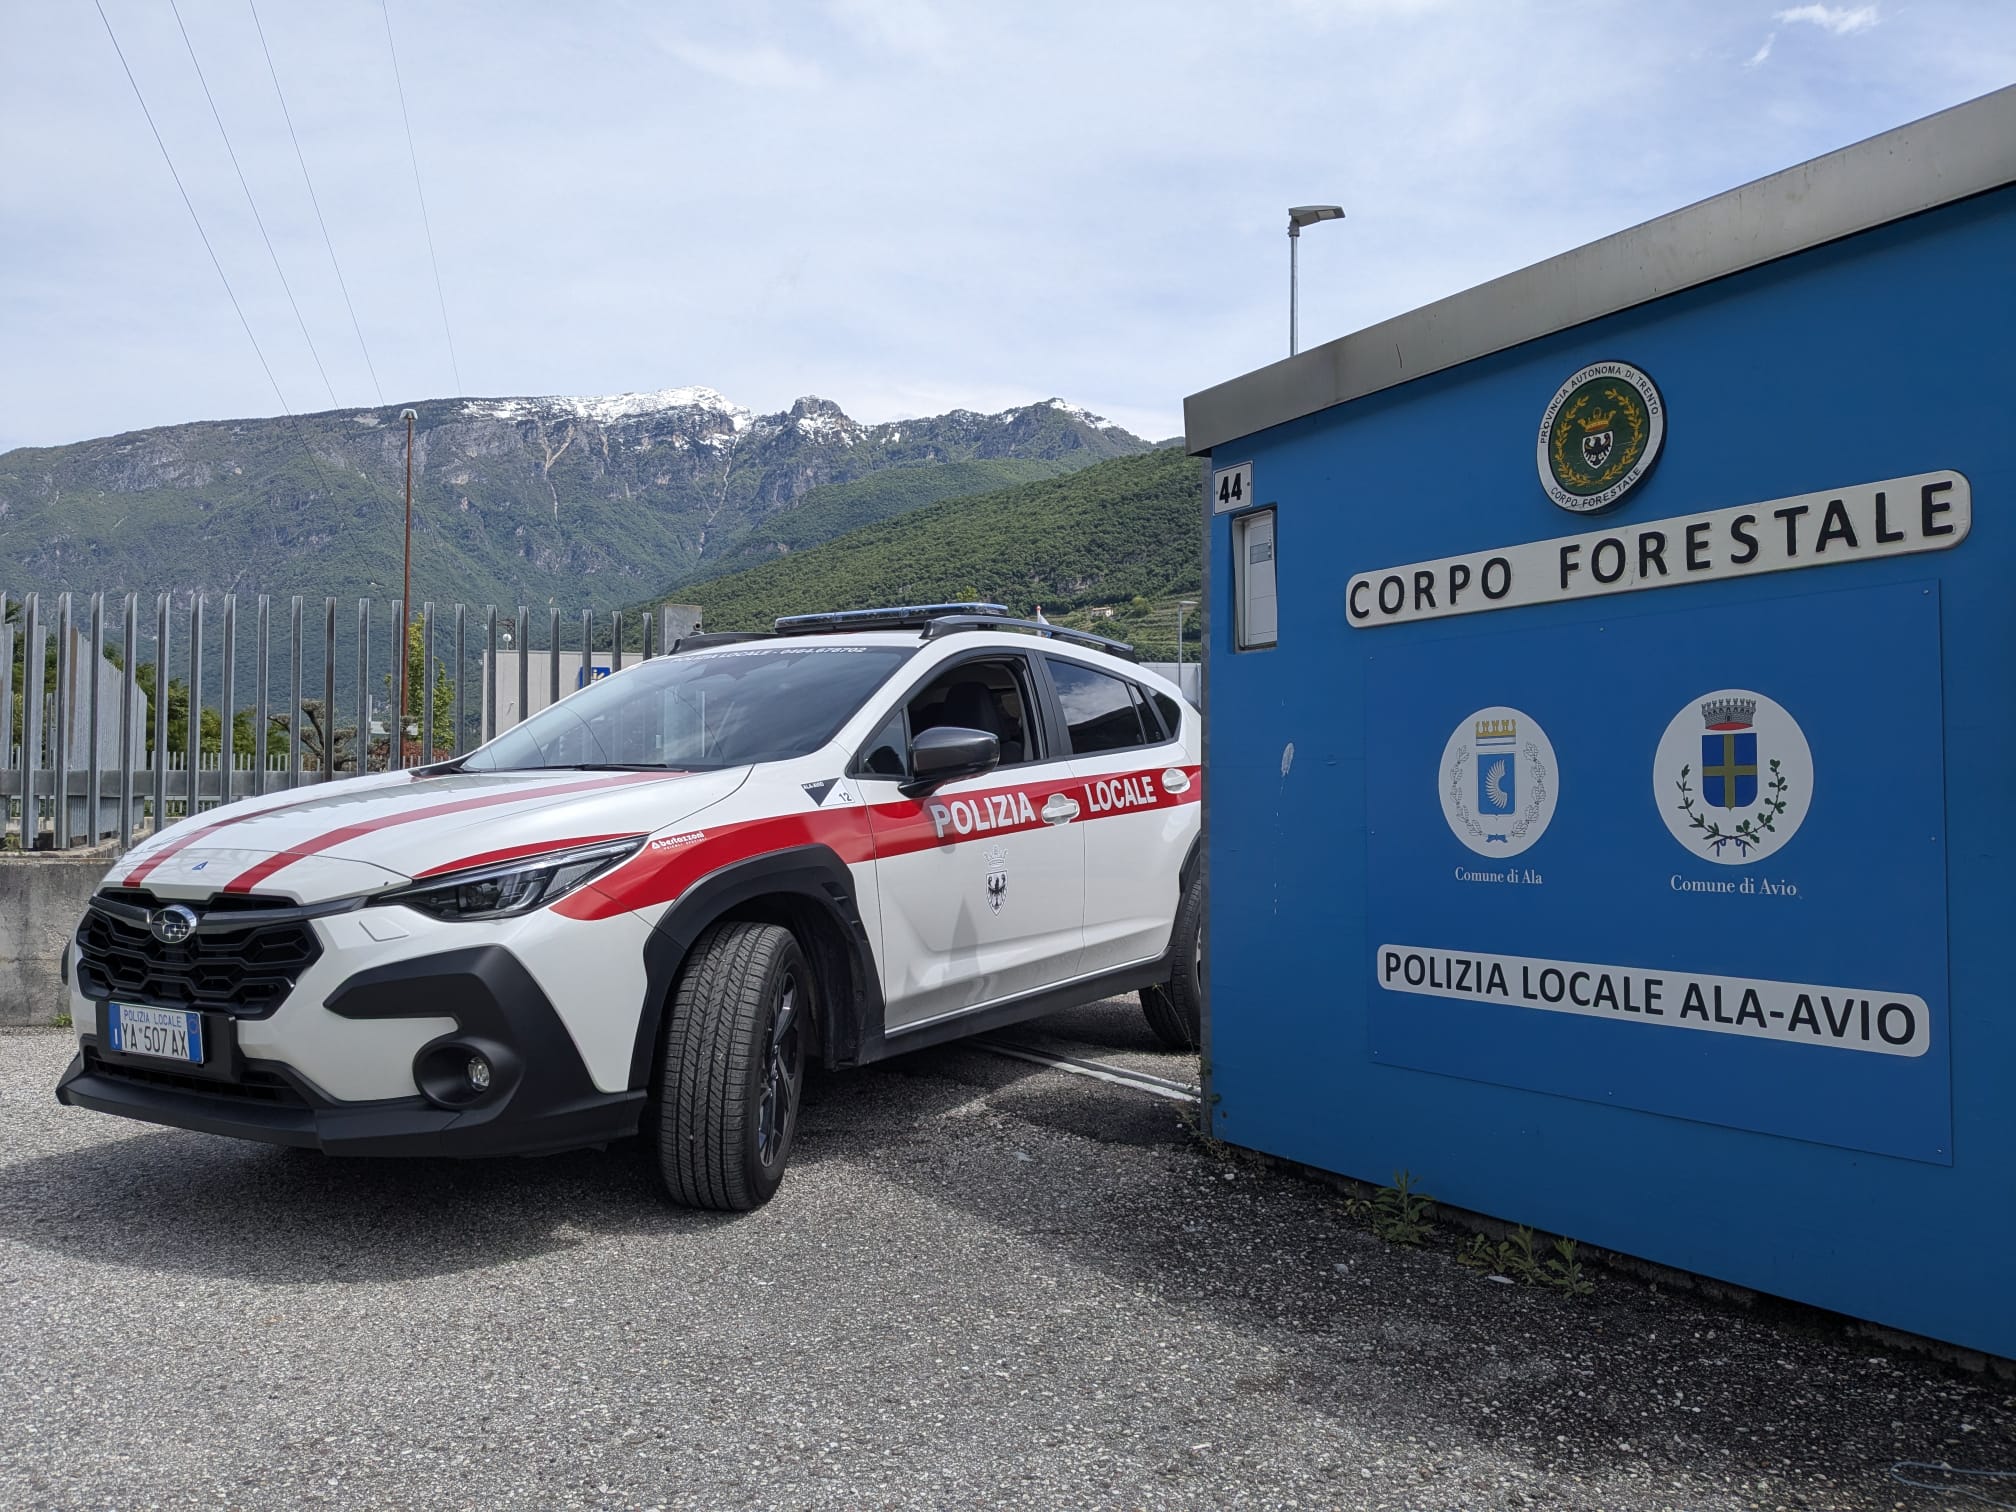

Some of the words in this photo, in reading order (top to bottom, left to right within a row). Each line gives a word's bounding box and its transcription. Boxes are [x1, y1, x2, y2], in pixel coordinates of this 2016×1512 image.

[1540, 388, 1569, 444] PROVINCIA
[1571, 365, 1621, 389] AUTONOMA
[1625, 369, 1634, 380] DI
[1635, 376, 1659, 415] TRENTO
[1218, 472, 1243, 504] 44
[1551, 487, 1578, 507] CORPO
[1582, 467, 1642, 508] FORESTALE
[1349, 556, 1512, 619] CORPO
[1559, 480, 1955, 590] FORESTALE
[838, 792, 853, 802] 12
[931, 791, 1037, 839] POLIZIA
[1084, 775, 1157, 813] LOCALE
[1455, 866, 1504, 883] Comune
[1507, 868, 1519, 884] di
[1522, 868, 1544, 885] Ala
[1670, 874, 1736, 893] Comune
[1739, 877, 1755, 895] di
[1759, 878, 1798, 896] Avio
[1385, 951, 1509, 997] POLIZIA
[1522, 965, 1664, 1016] LOCALE
[1679, 982, 1916, 1045] ALA-AVIO
[123, 1008, 150, 1022] POLIZIA
[153, 1012, 182, 1028] LOCALE
[121, 1022, 138, 1050] YA
[143, 1026, 168, 1054] 507
[171, 1030, 188, 1057] AX
